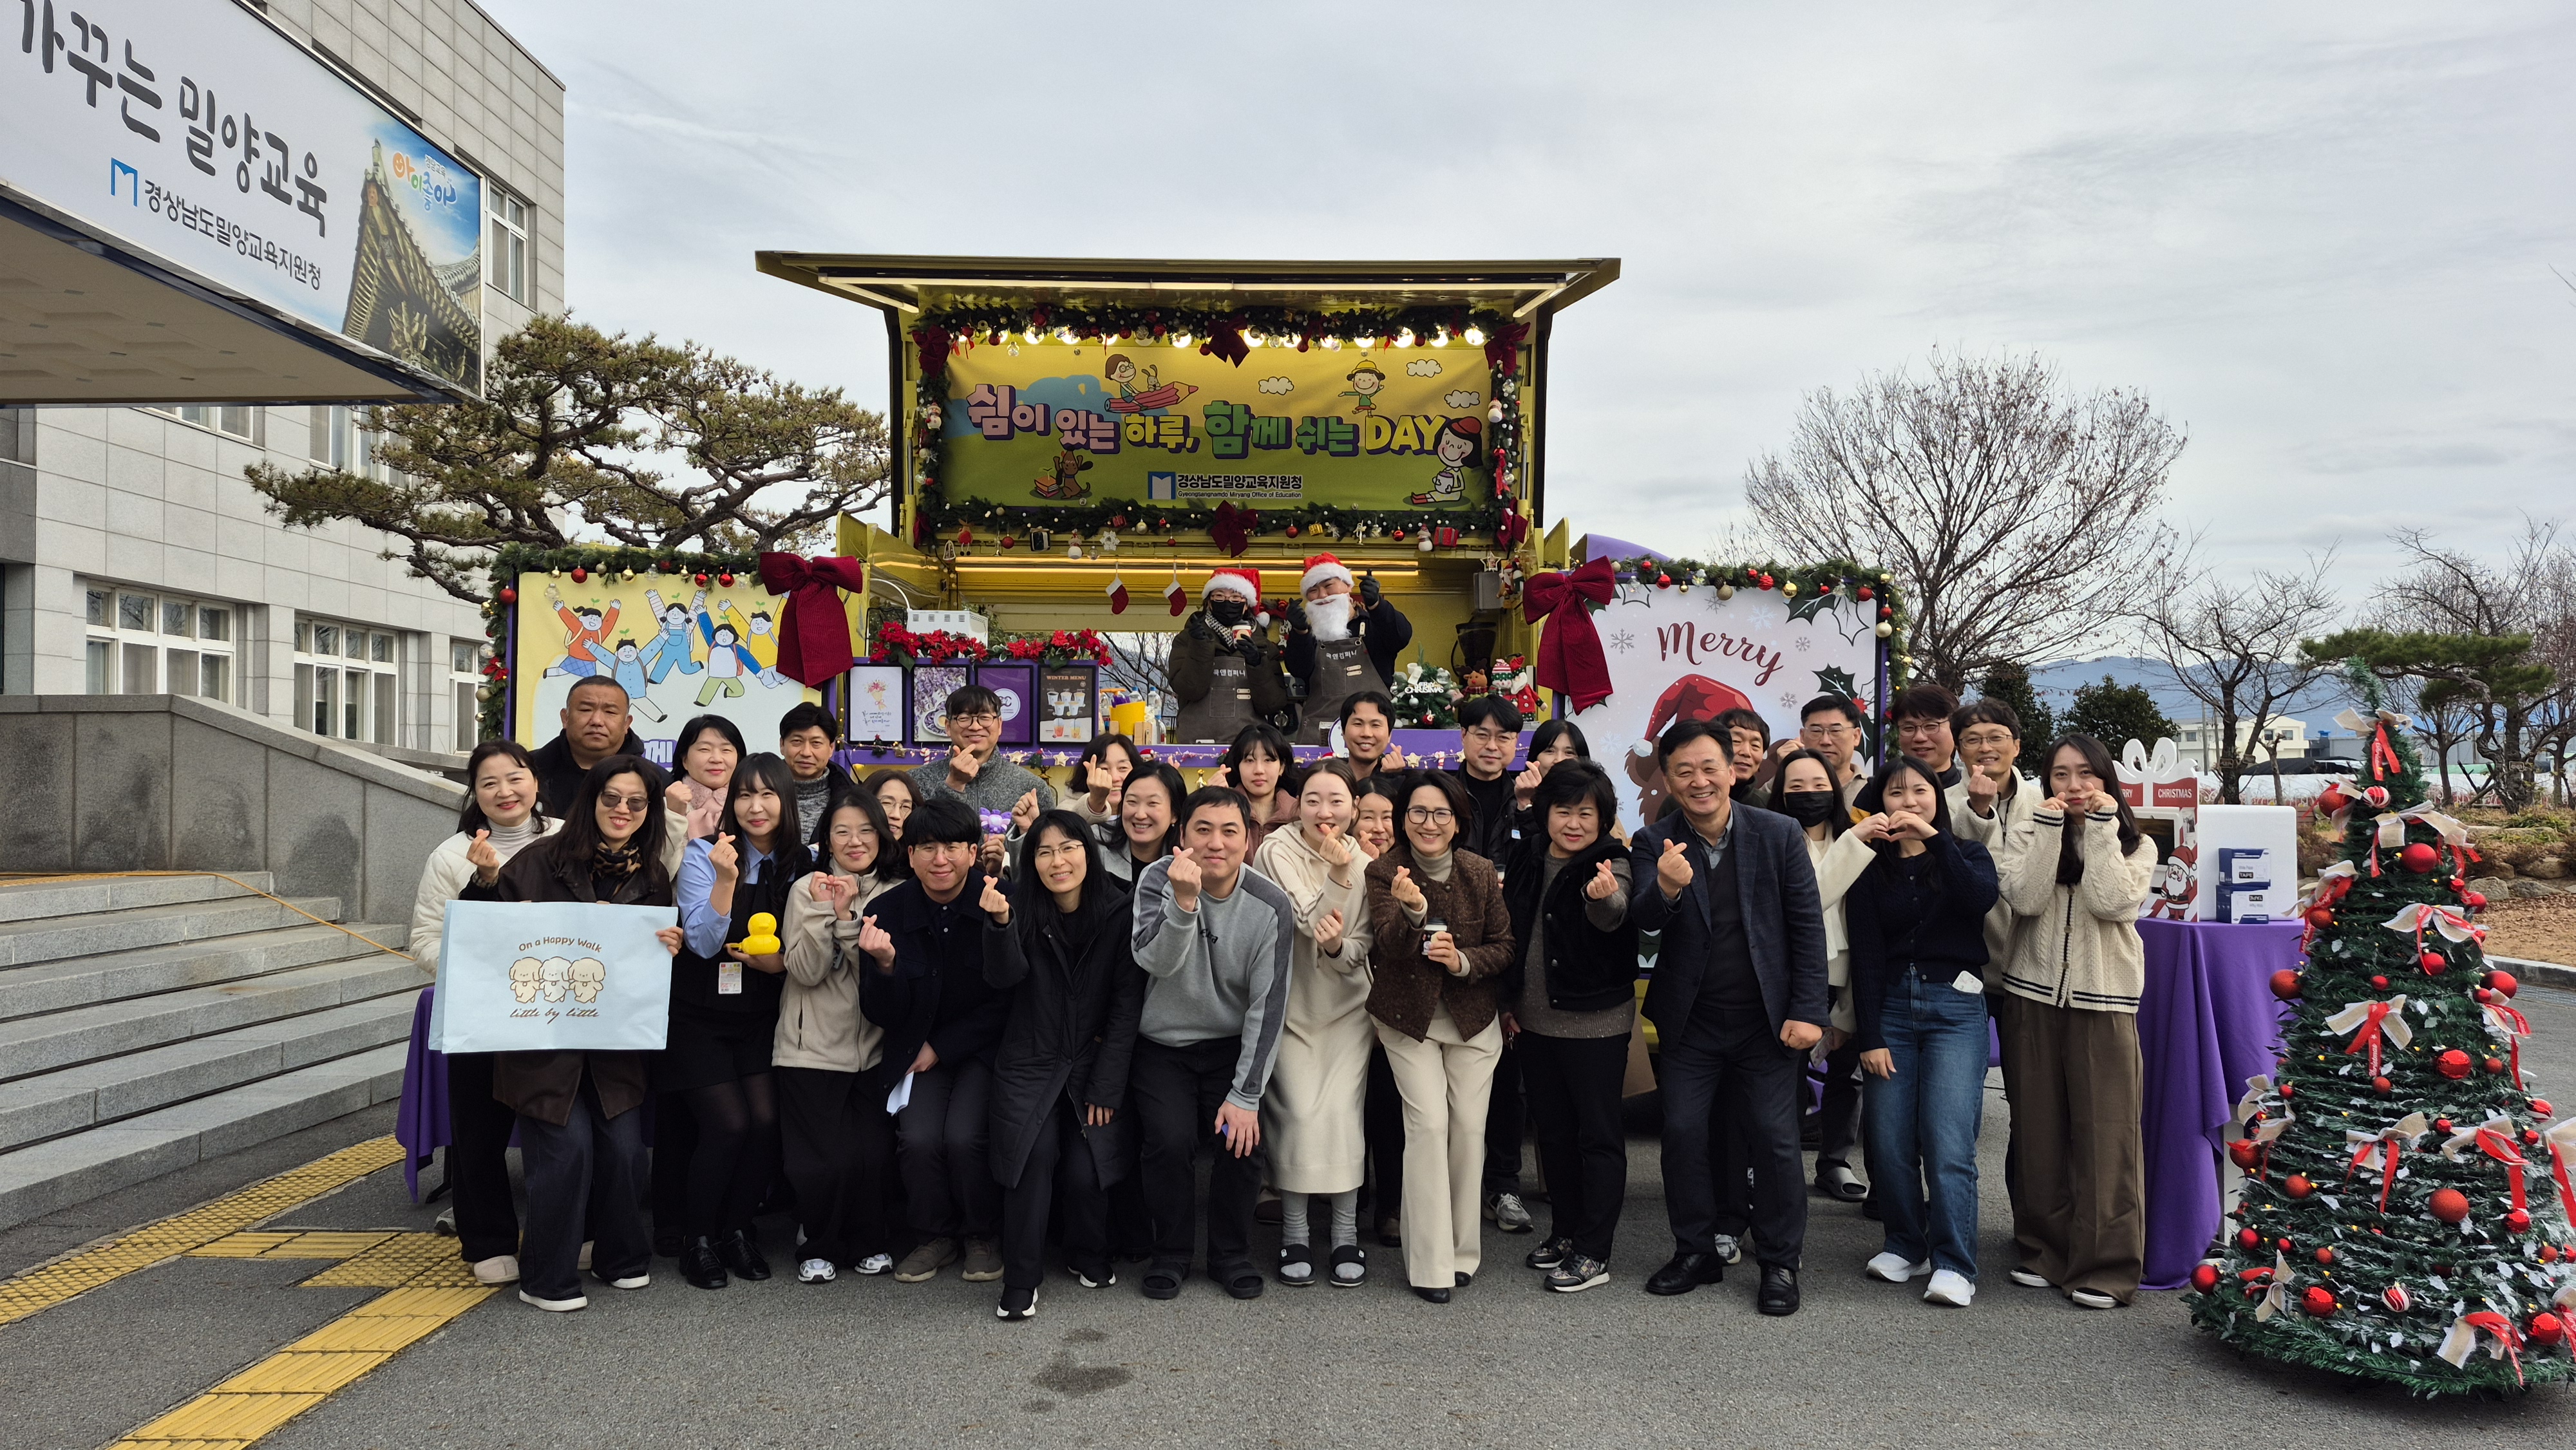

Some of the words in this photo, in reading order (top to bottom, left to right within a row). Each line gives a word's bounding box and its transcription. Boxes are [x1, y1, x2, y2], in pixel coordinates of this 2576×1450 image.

[179, 75, 328, 238] 밀양교육
[425, 155, 446, 178] 경남교육
[144, 179, 322, 290] 경상남도밀양교육지원청
[967, 384, 1049, 439] 쉼이
[1055, 409, 1119, 453] 있는
[1124, 413, 1198, 452] 하루,
[1204, 400, 1291, 459] 함께
[1296, 416, 1358, 456] 쉬는
[1365, 415, 1449, 455] DAY
[1178, 475, 1302, 489] 경상남도밀양교육지원청
[1656, 621, 1784, 686] Merry
[2121, 789, 2133, 798] RRY
[2157, 788, 2192, 798] CHRISTMAS
[518, 941, 533, 952] On
[544, 936, 575, 946] Happy
[578, 937, 602, 953] Walk
[509, 1008, 540, 1018] little
[545, 1008, 560, 1024] by
[565, 1008, 600, 1018] little
